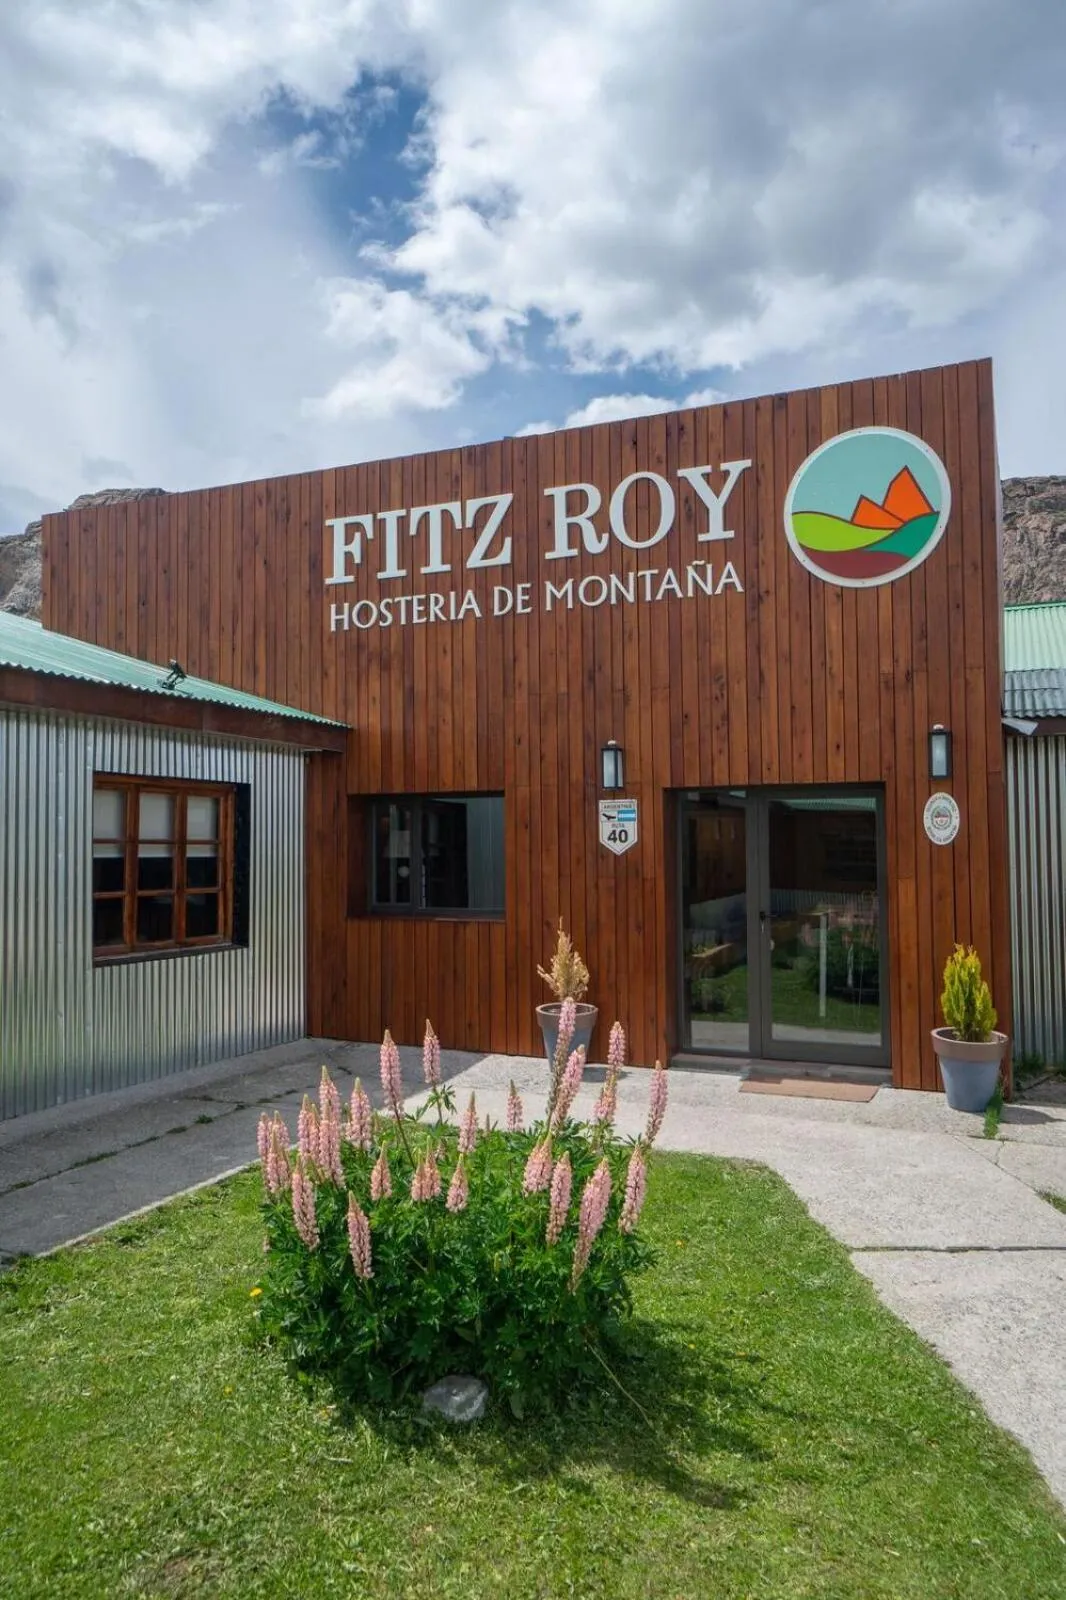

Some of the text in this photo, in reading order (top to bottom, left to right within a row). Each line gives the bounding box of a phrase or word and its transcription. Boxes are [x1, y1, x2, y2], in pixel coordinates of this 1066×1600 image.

[324, 458, 753, 586] FITZ ROY
[330, 559, 745, 632] HOSTERIA DE MONTAÑA
[607, 829, 629, 844] 40
